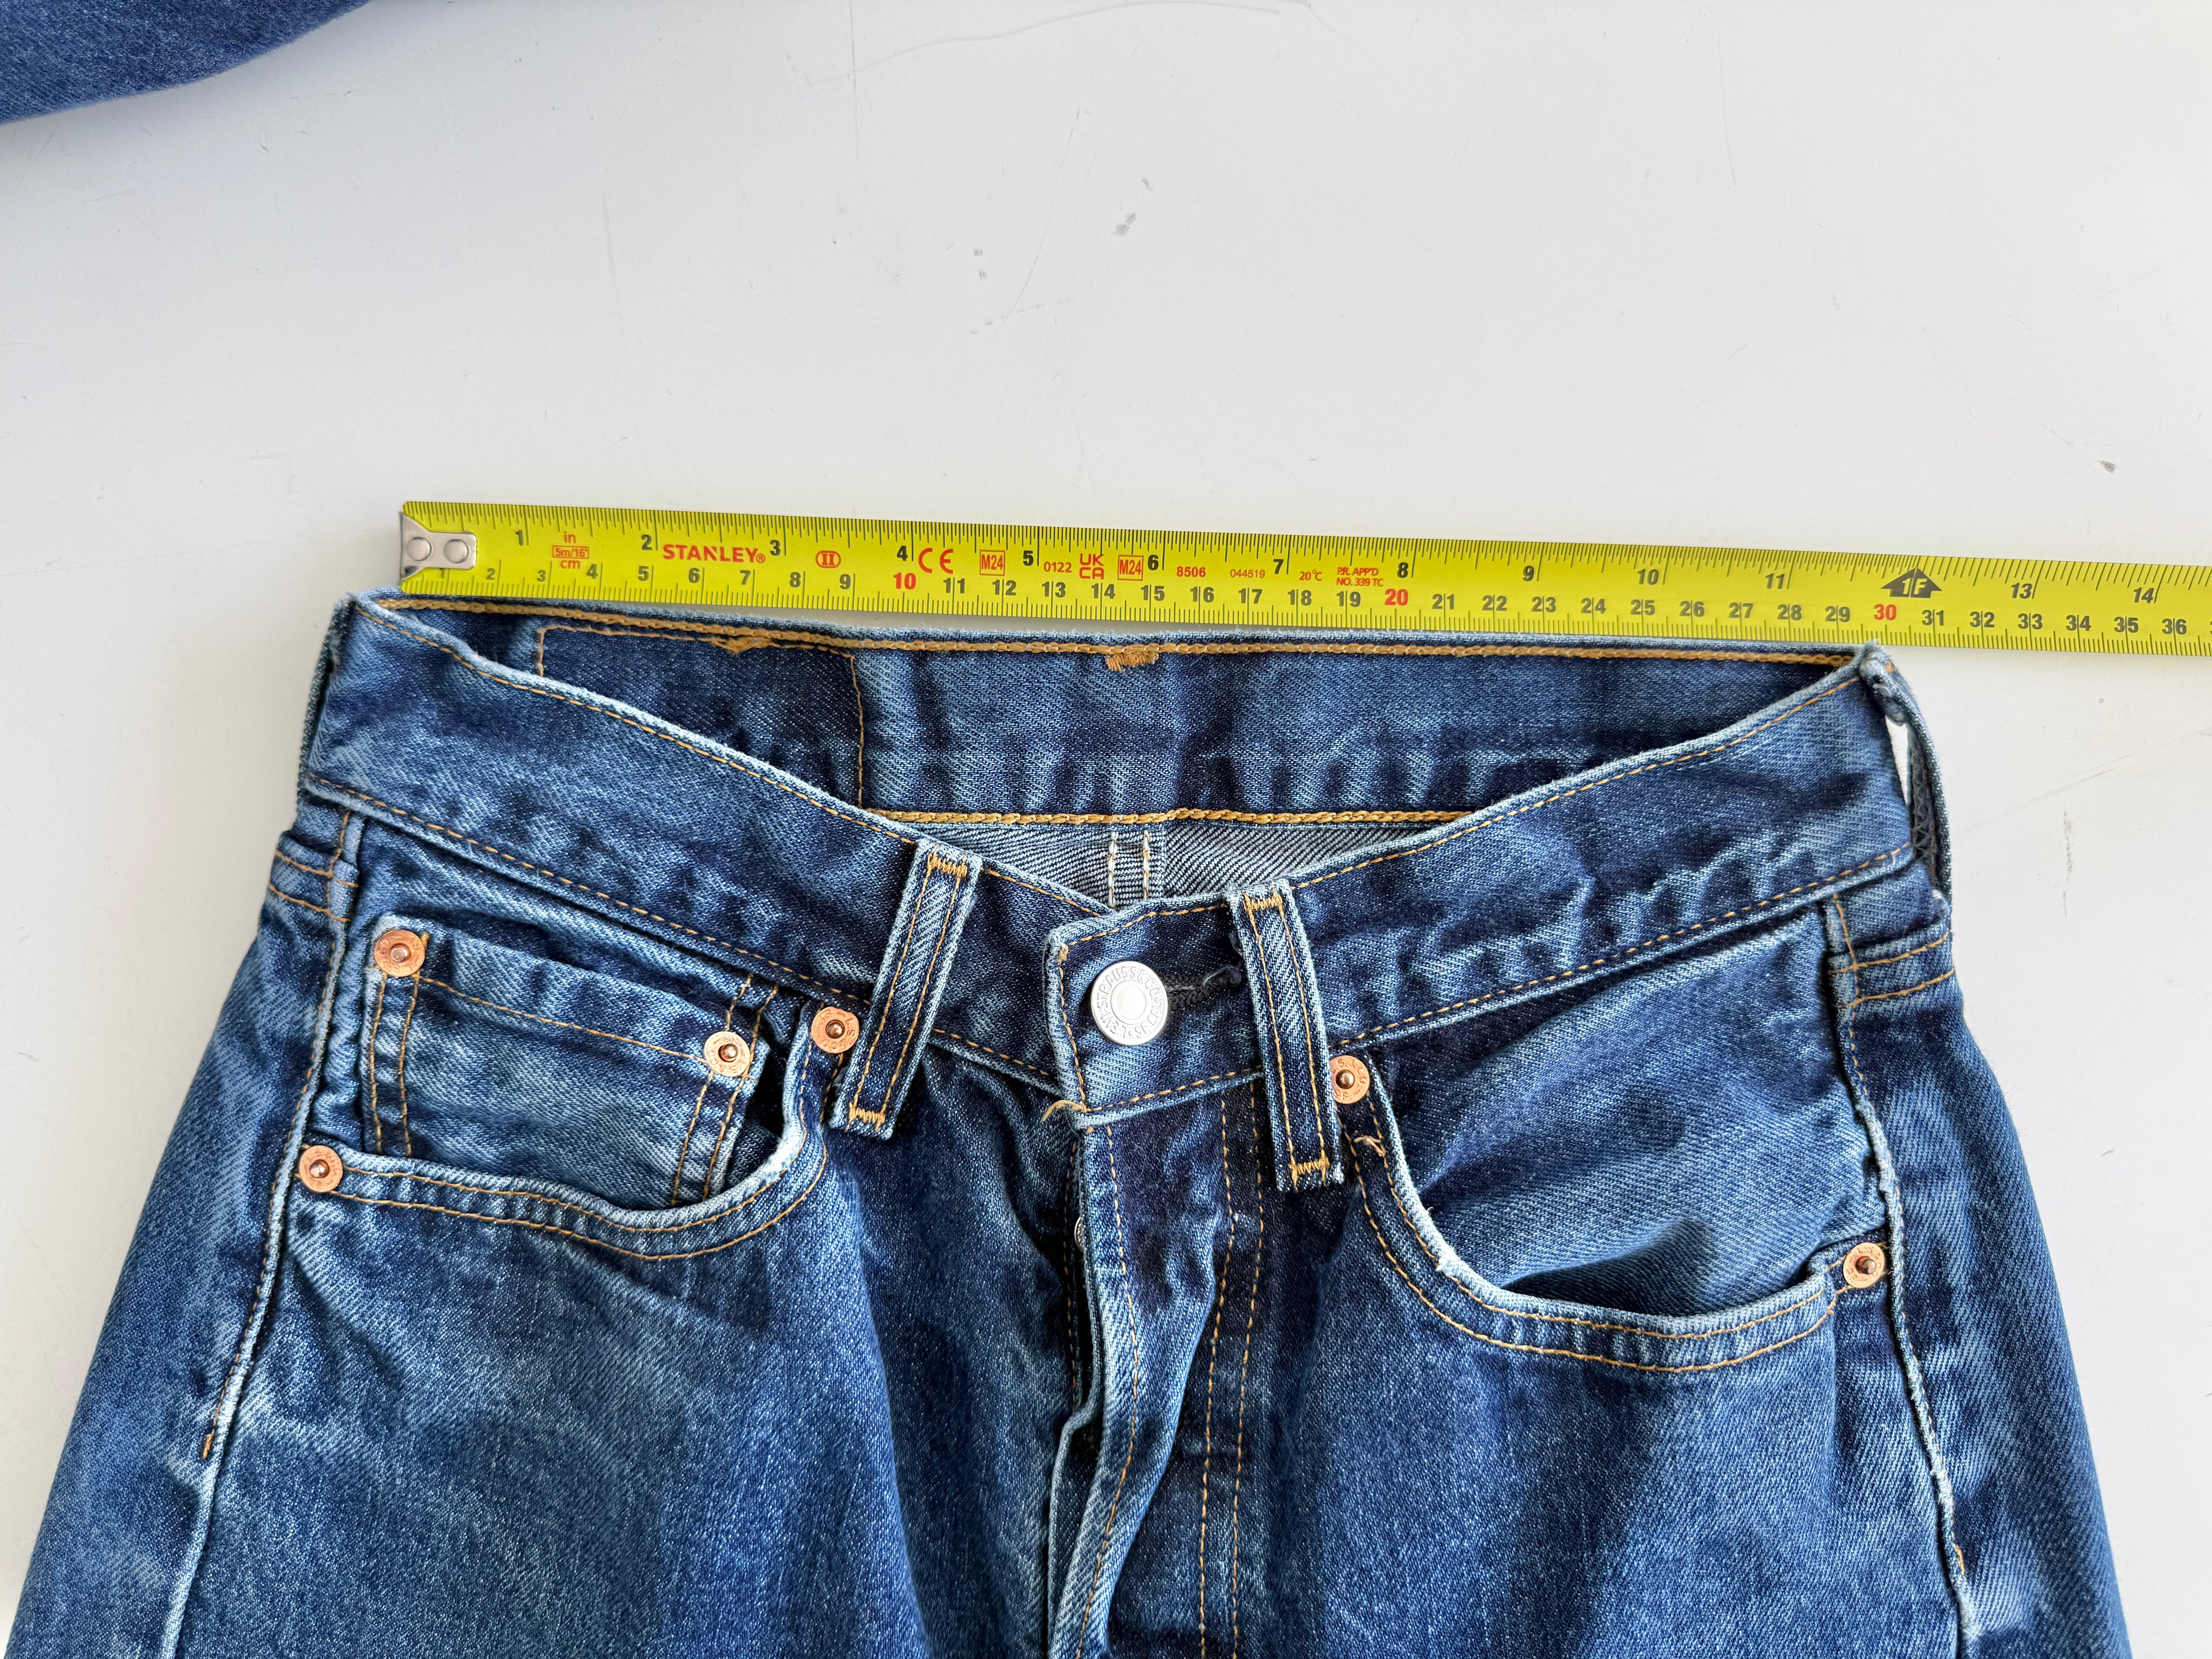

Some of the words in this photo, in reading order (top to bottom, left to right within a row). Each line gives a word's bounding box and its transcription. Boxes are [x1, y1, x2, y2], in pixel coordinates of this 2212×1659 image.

[516, 530, 524, 546] 1
[563, 531, 577, 544] in
[641, 535, 653, 551] 2
[770, 540, 781, 556] 3
[897, 546, 908, 562] 4
[560, 560, 581, 570] cm
[981, 554, 1004, 570] M24
[1022, 551, 1034, 566] 5
[1079, 554, 1104, 566] UK
[1147, 555, 1159, 571] 6
[487, 568, 495, 580] 2
[586, 564, 598, 579] 4
[638, 566, 649, 581] 5
[1044, 562, 1072, 573] 0122
[1079, 567, 1104, 579] CA
[1119, 559, 1142, 575] M24
[1177, 566, 1206, 578] 8506
[1230, 569, 1265, 578] 044519
[1273, 559, 1284, 575] 7
[1397, 562, 1409, 578] 8
[1522, 566, 1535, 582] 9
[537, 570, 546, 582] 3
[688, 568, 700, 584] 6
[740, 570, 751, 585] 7
[790, 572, 801, 588] 8
[840, 574, 851, 589] 9
[893, 573, 916, 590] 10
[1336, 577, 1353, 586] NO.
[1354, 578, 1370, 586] 339
[1372, 578, 1384, 587] TC
[1637, 569, 1659, 585] 10
[1765, 573, 1785, 590] 11
[944, 578, 965, 594] 11
[993, 579, 1017, 596] 12
[1042, 581, 1066, 598] 13
[1092, 583, 1115, 599] 14
[1141, 585, 1165, 601] 15
[2011, 583, 2032, 599] 13
[1190, 586, 1214, 603] 16
[1238, 588, 1262, 604] 17
[1288, 589, 1312, 606] 18
[1336, 591, 1361, 607] 19
[1384, 589, 1408, 606] 20
[1431, 594, 1455, 610] 21
[2133, 587, 2154, 604] 14
[1482, 595, 1508, 612] 22
[1531, 596, 1556, 613] 23
[1581, 598, 1606, 614] 24
[1630, 599, 1655, 615] 25
[1679, 601, 1705, 617] 26
[1729, 603, 1753, 619] 27
[1777, 604, 1802, 620] 28
[1825, 606, 1850, 622] 29
[1873, 604, 1897, 620] 30
[1922, 610, 1944, 626] 31
[1969, 612, 1994, 627] 32
[2017, 613, 2043, 630] 33
[2066, 615, 2091, 631] 34
[2113, 617, 2138, 633] 35
[2162, 618, 2187, 635] 36
